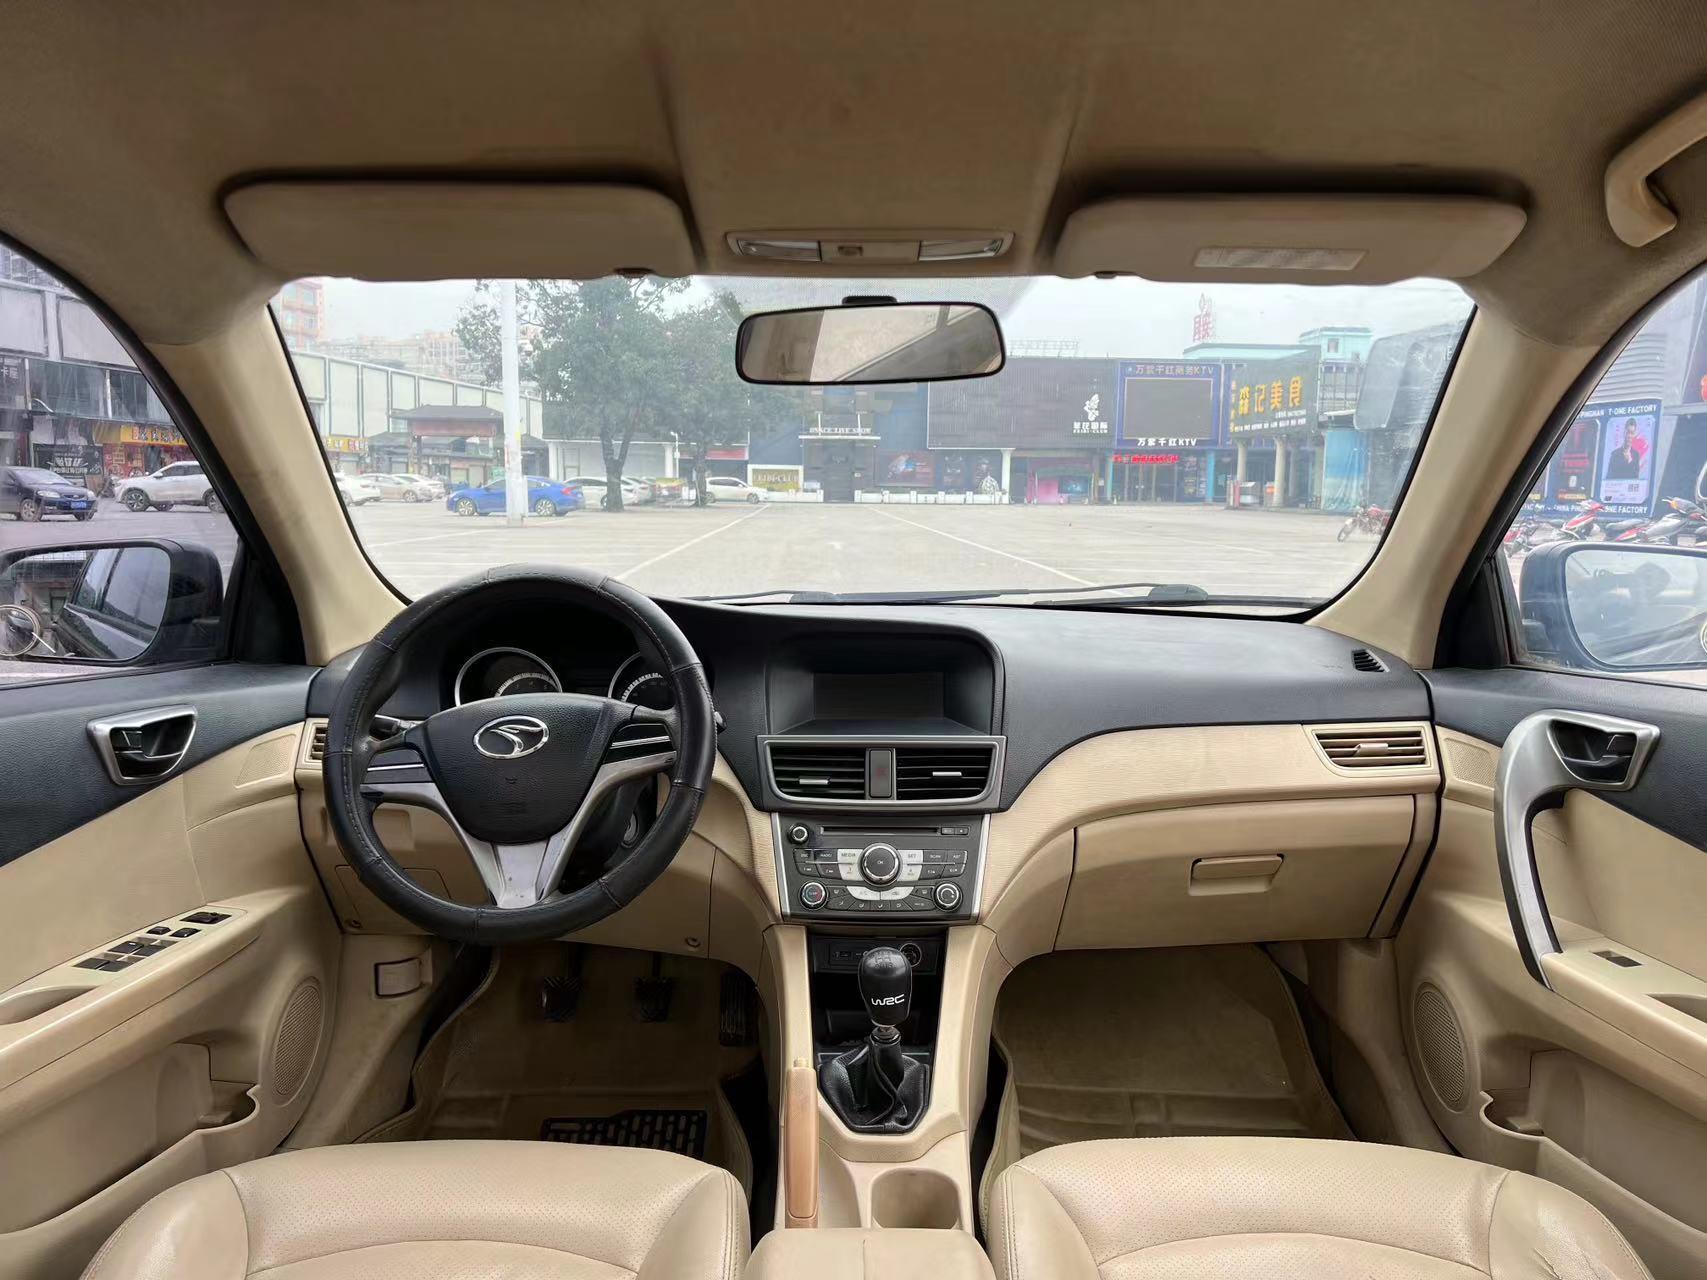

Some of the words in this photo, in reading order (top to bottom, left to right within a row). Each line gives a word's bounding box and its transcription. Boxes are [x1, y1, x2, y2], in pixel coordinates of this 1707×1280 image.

[1629, 404, 1657, 414] FACTORY
[1618, 505, 1648, 514] FACTORY
[871, 993, 905, 1006] WRC
